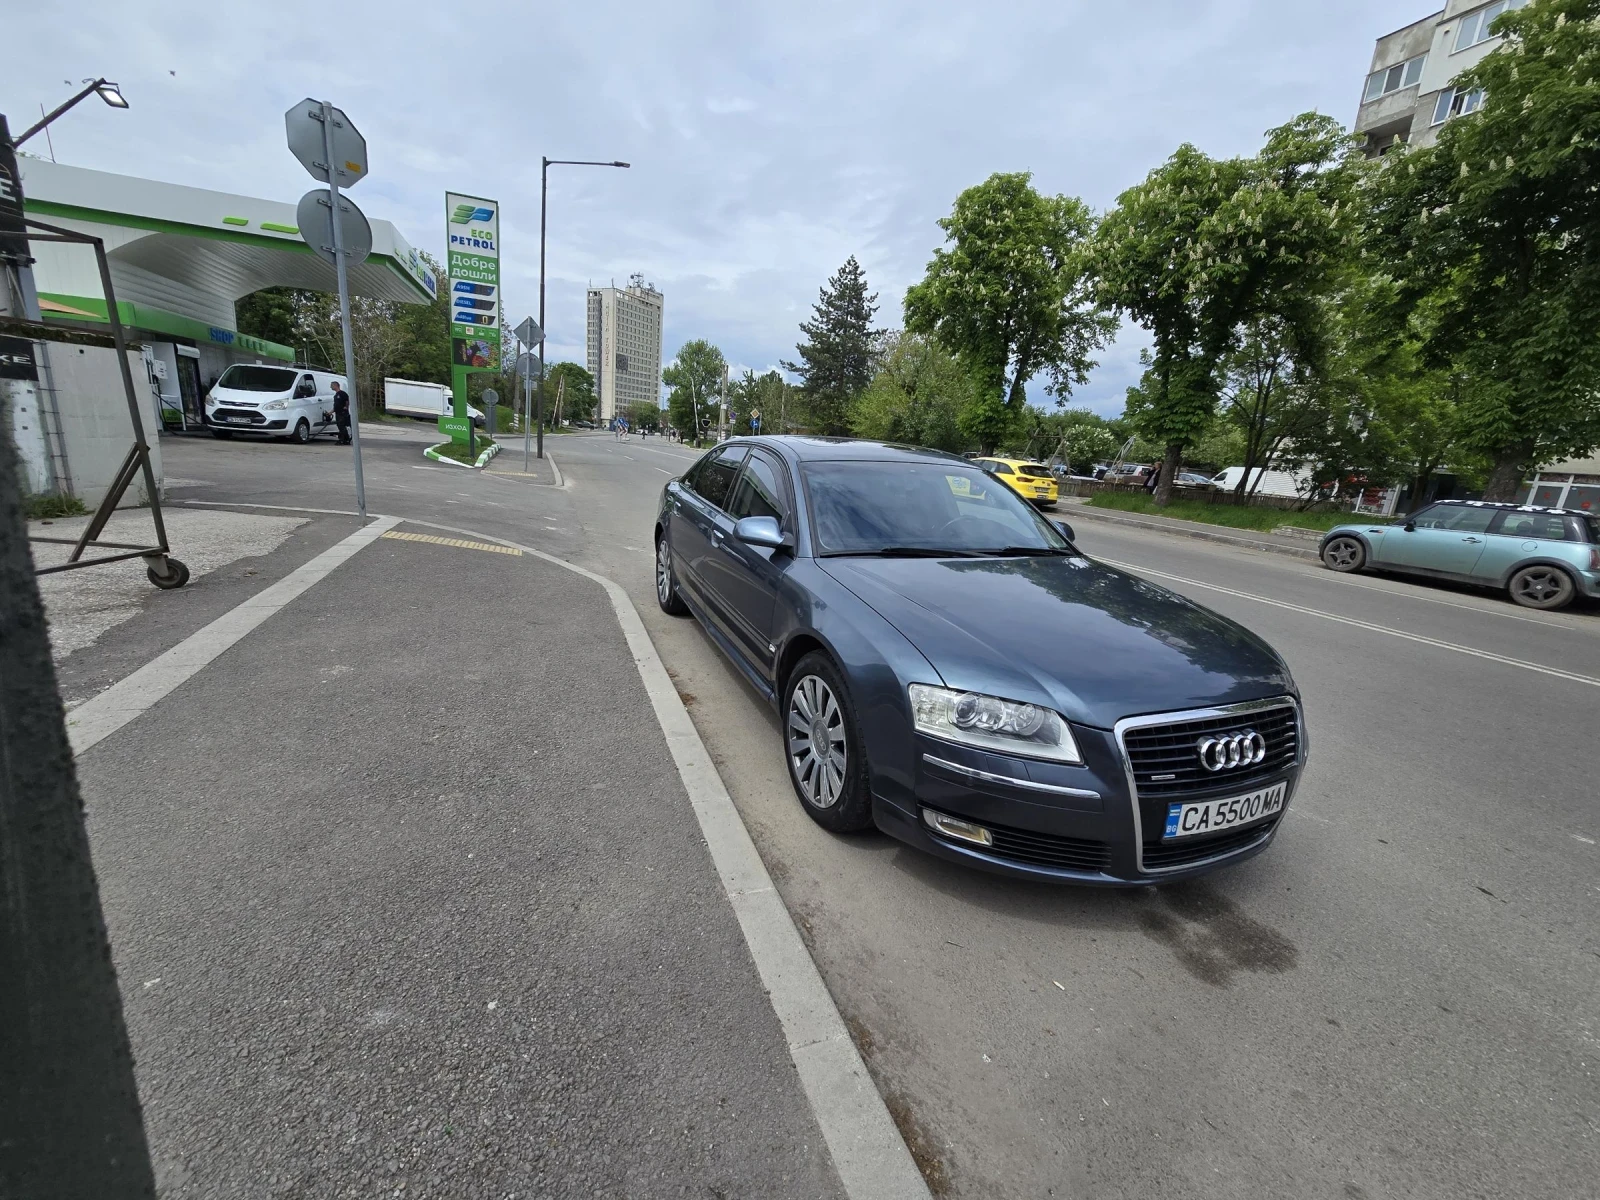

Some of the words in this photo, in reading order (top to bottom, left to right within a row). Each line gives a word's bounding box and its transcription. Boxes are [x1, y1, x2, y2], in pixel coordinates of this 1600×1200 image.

[450, 234, 496, 250] PETROL
[471, 229, 493, 240] ECO
[452, 254, 496, 270] Добре
[452, 267, 496, 281] дошли
[210, 327, 235, 345] SHOP
[1182, 805, 1210, 832] CA
[1213, 794, 1261, 827] 5500
[1260, 786, 1282, 814] MA
[1166, 824, 1177, 833] BG
